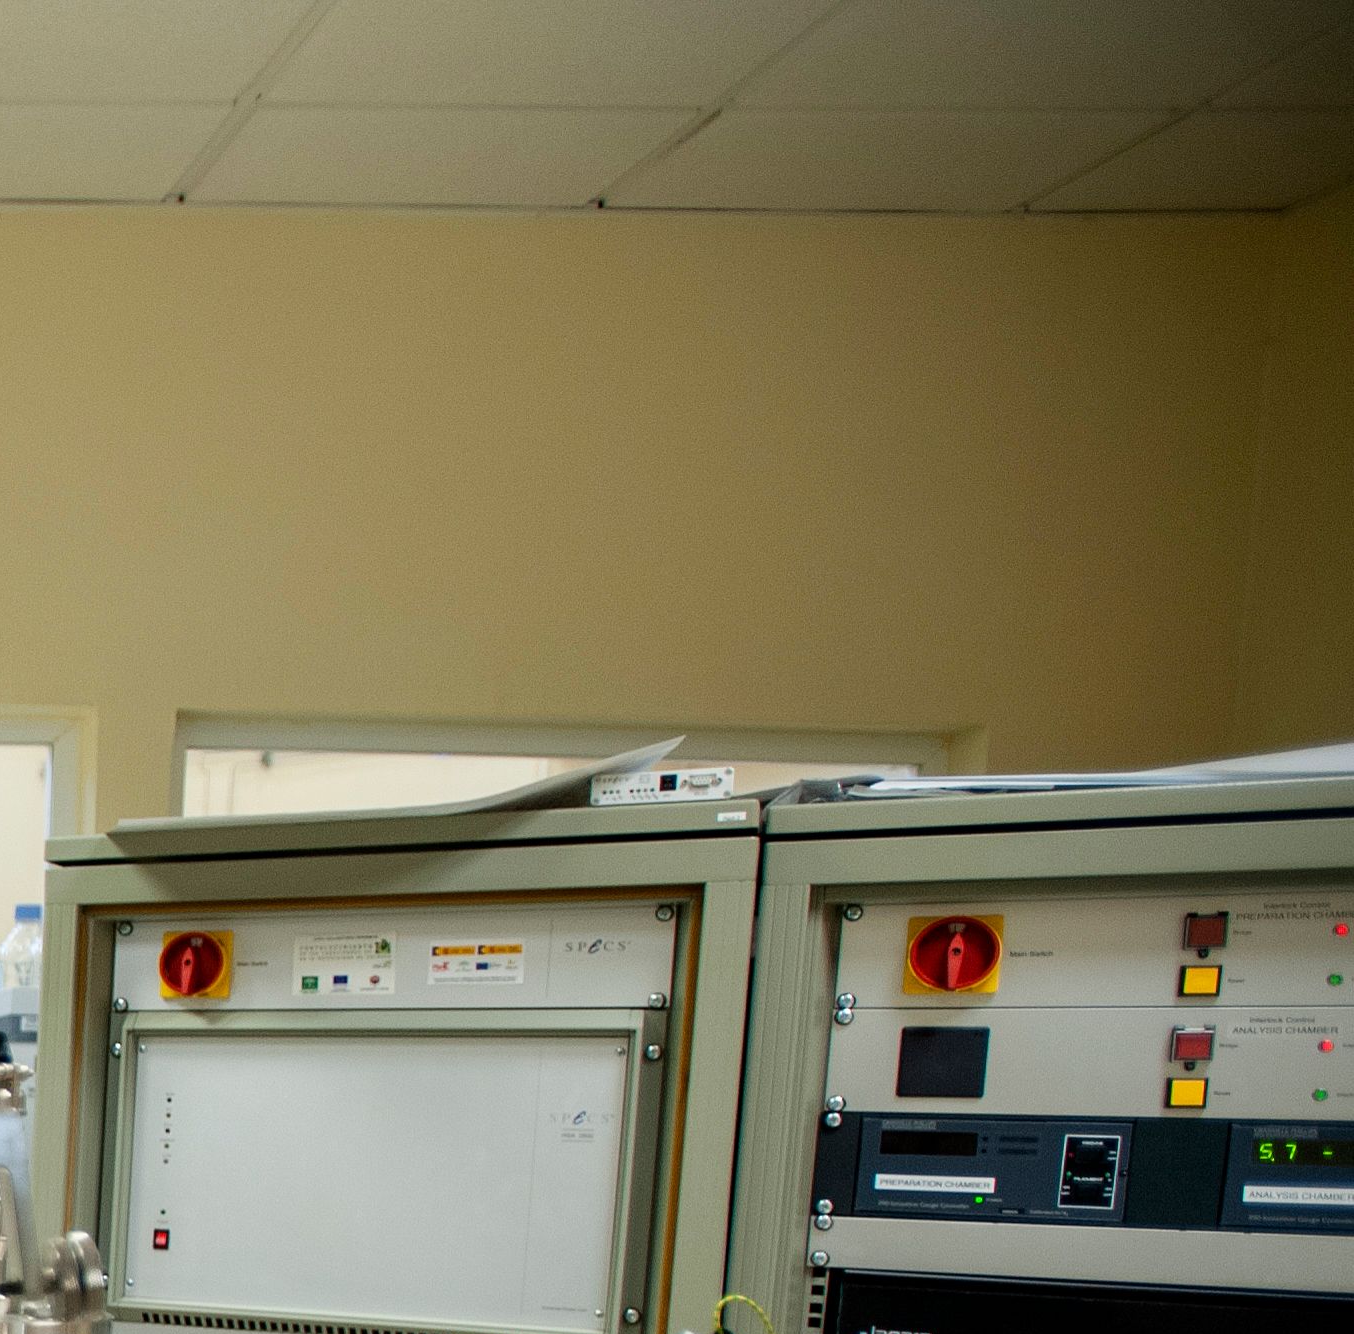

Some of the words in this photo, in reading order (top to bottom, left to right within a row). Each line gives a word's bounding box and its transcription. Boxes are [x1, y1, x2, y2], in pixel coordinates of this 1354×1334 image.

[1232, 1026, 1282, 1035] ANALYSIS
[1285, 1026, 1339, 1035] CHAMBER
[879, 1179, 943, 1189] PREPARATION
[945, 1181, 991, 1190] CHAMBER
[1249, 1190, 1299, 1200] ANALYSIS
